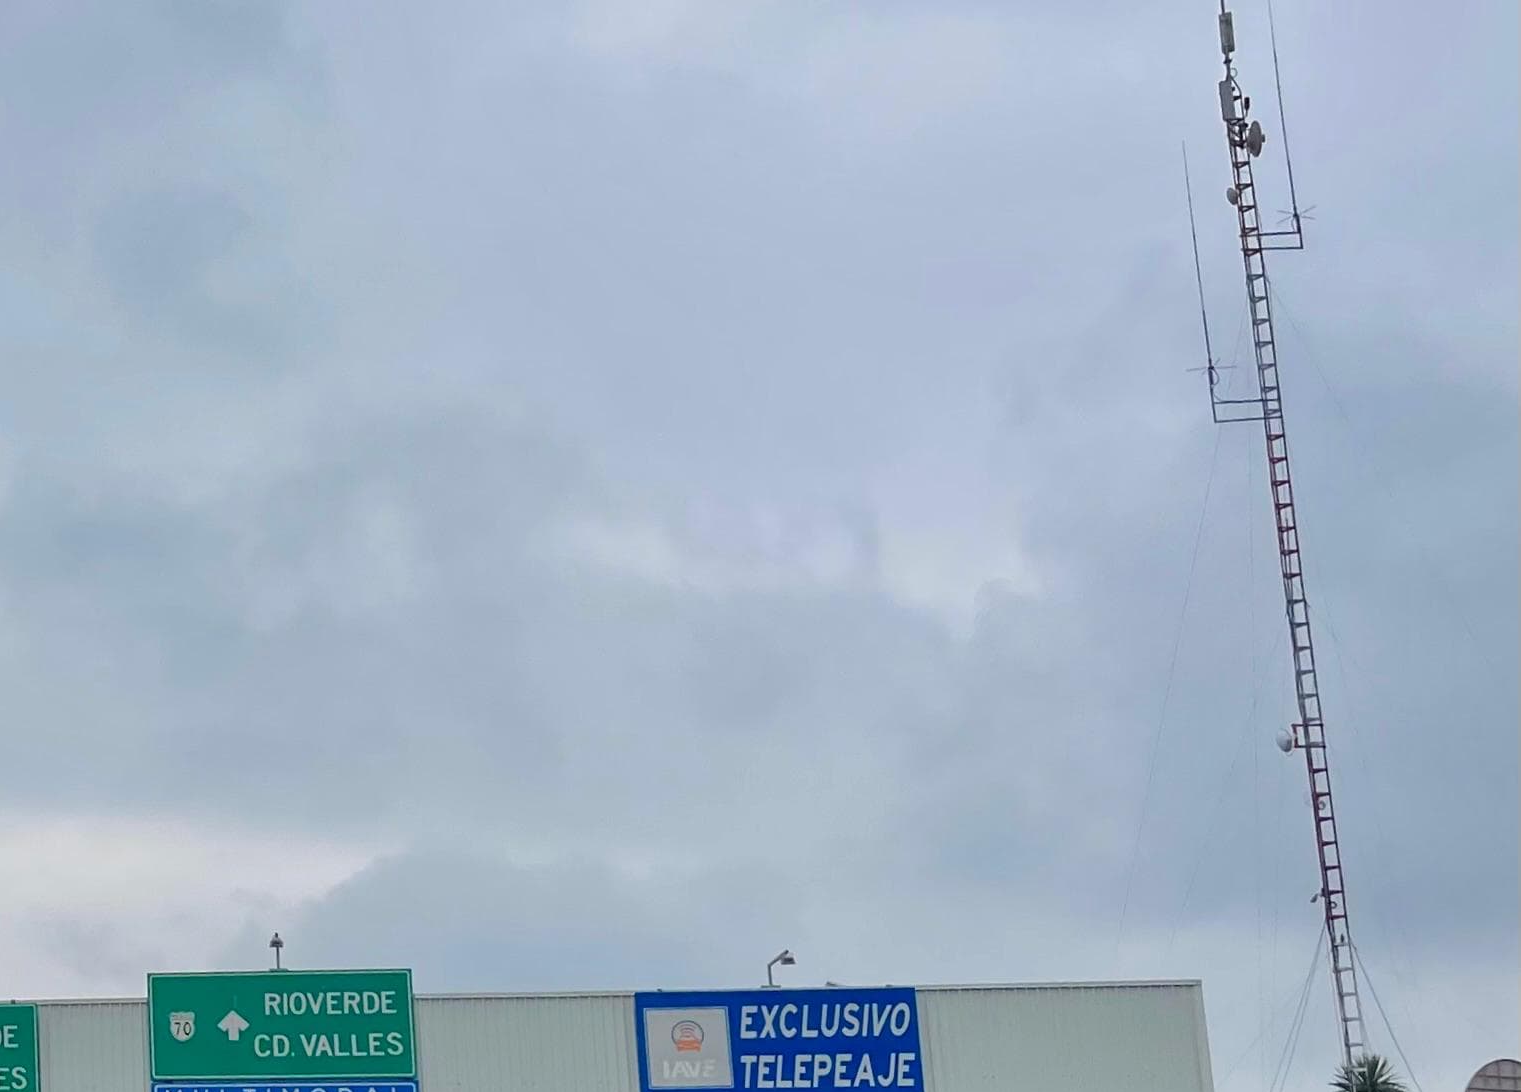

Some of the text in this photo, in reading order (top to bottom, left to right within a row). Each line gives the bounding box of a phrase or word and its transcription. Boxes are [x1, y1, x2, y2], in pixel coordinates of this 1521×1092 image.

[264, 991, 397, 1016] RIOVERDE
[174, 1021, 191, 1036] 70
[739, 1003, 911, 1039] EXCLUSIVO
[254, 1032, 404, 1057] CD. VALLES
[662, 1059, 716, 1079] IAVE
[740, 1053, 916, 1088] TELEPEAJE
